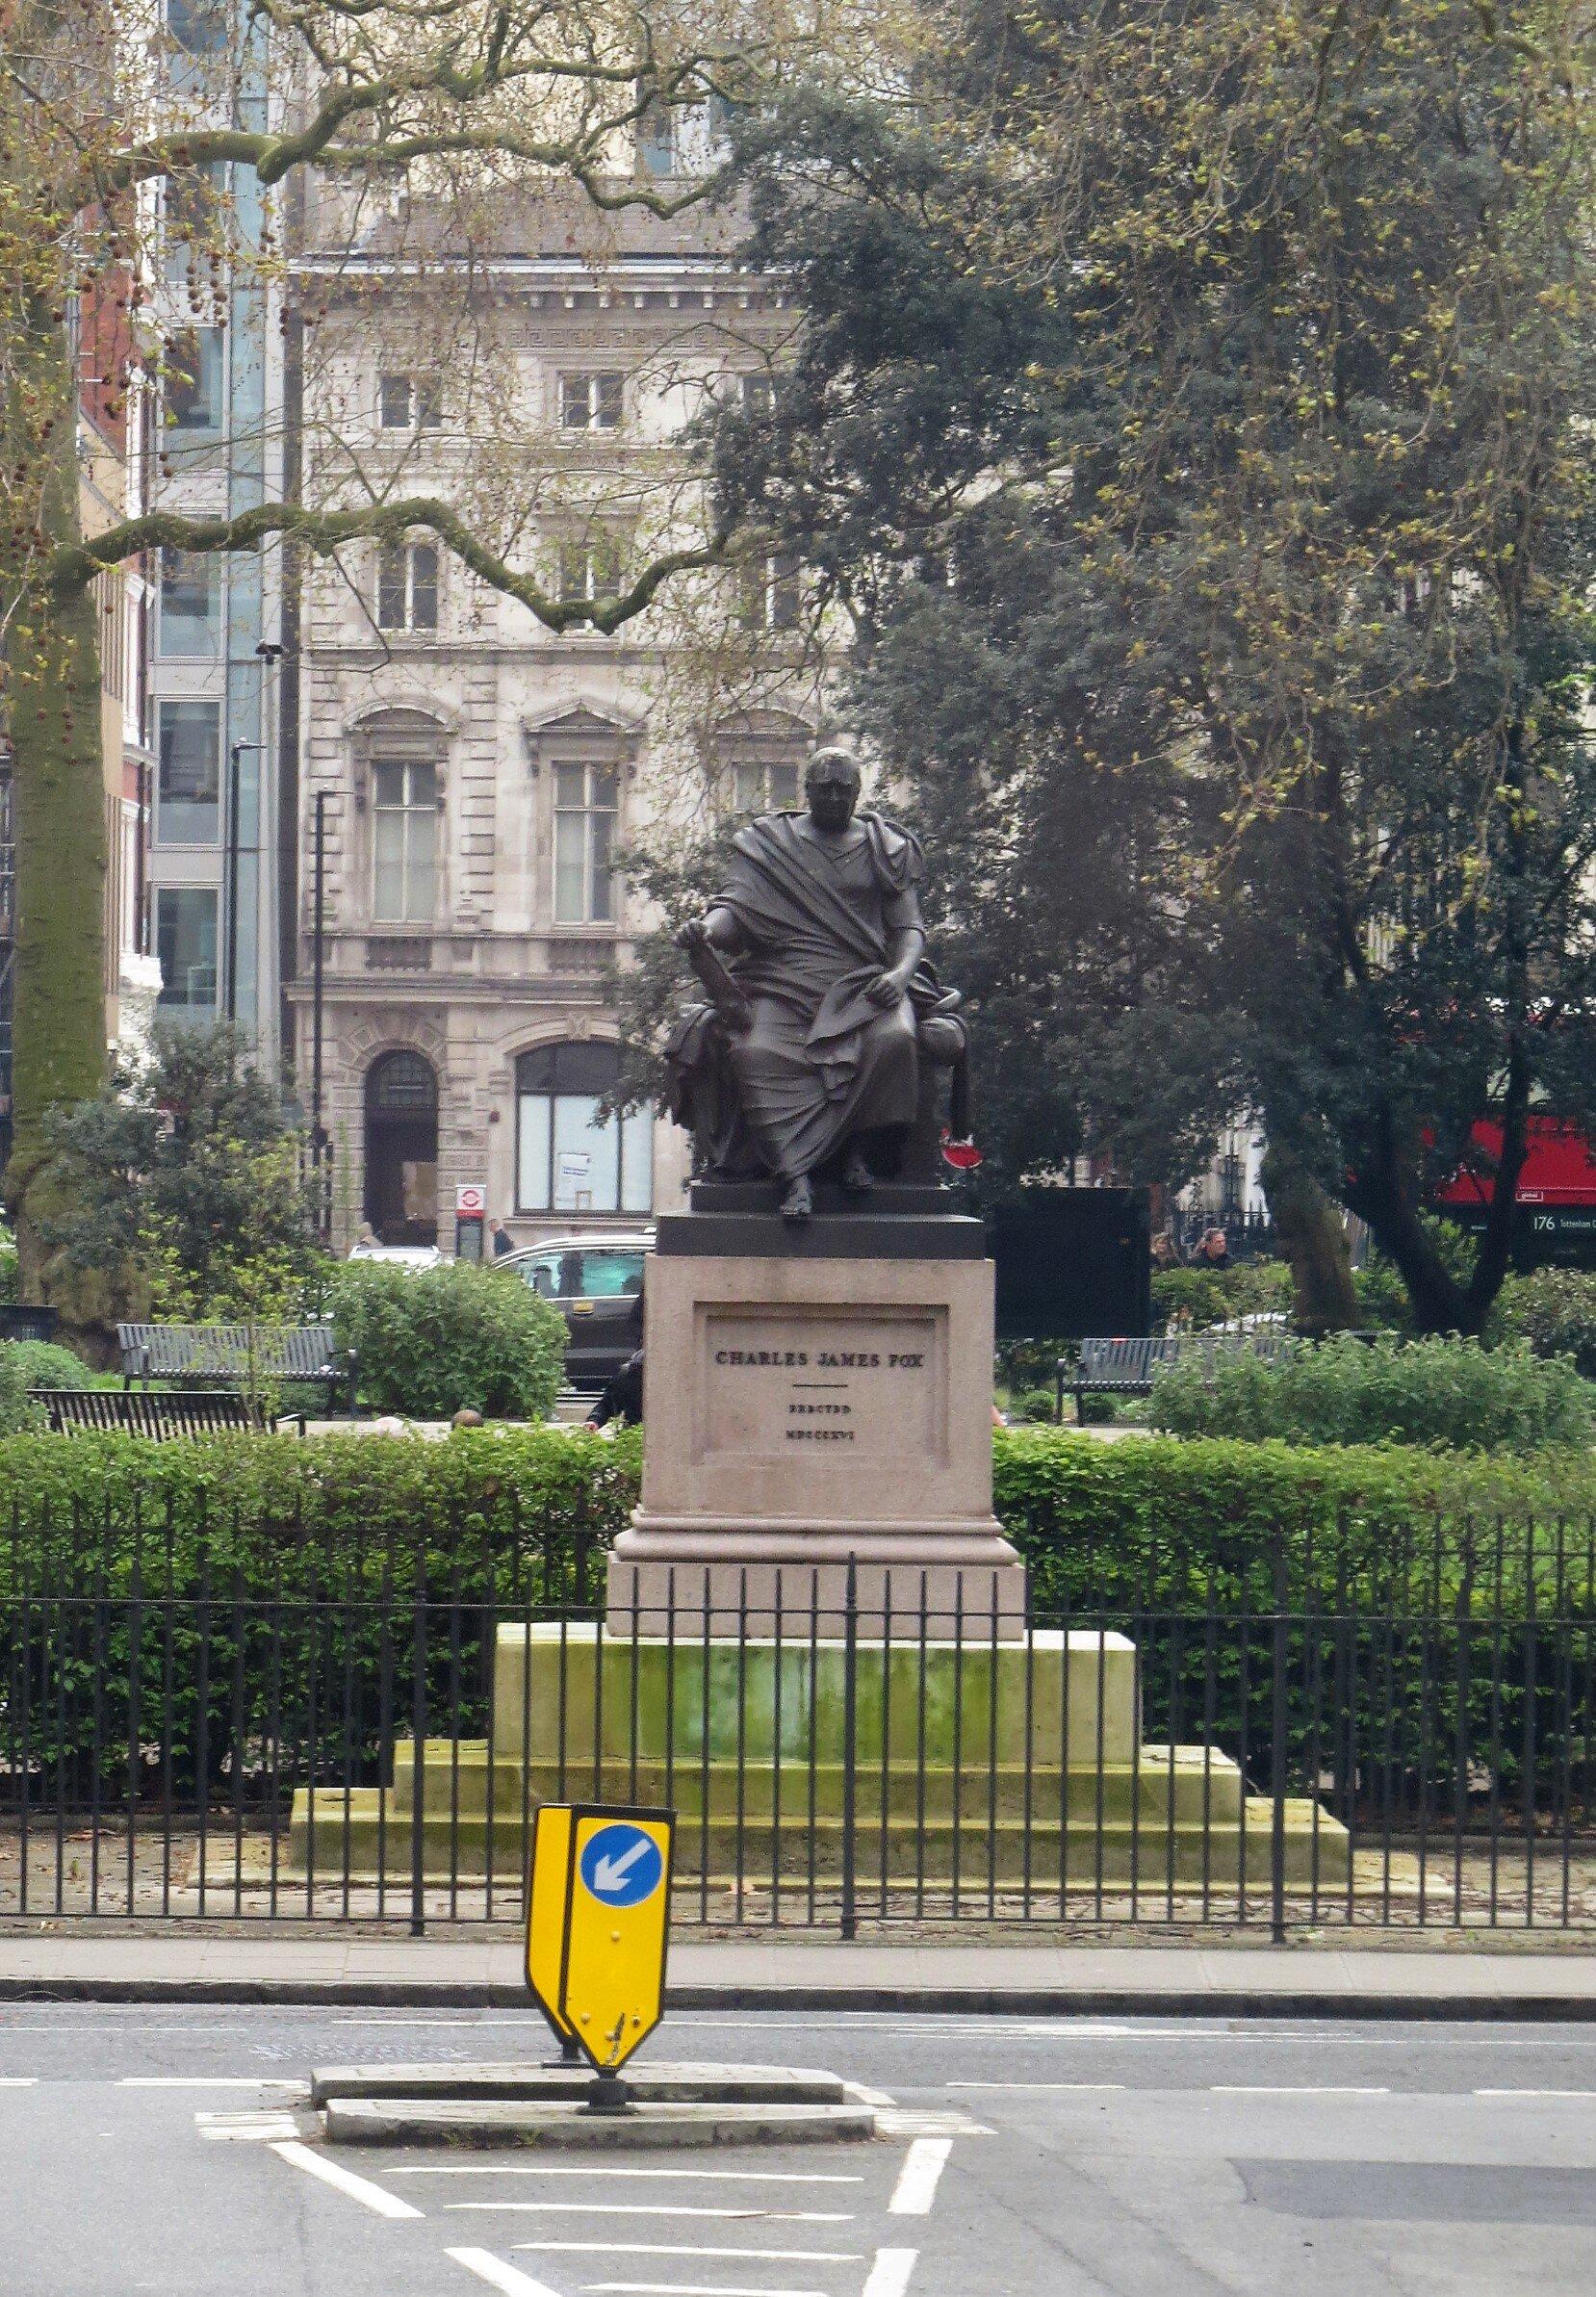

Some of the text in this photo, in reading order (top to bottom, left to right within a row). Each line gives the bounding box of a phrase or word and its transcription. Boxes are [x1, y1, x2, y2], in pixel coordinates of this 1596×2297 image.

[1534, 1216, 1556, 1230] 176
[715, 1351, 924, 1367] CHARLES JAMES FOX
[788, 1405, 852, 1413] ERECTED
